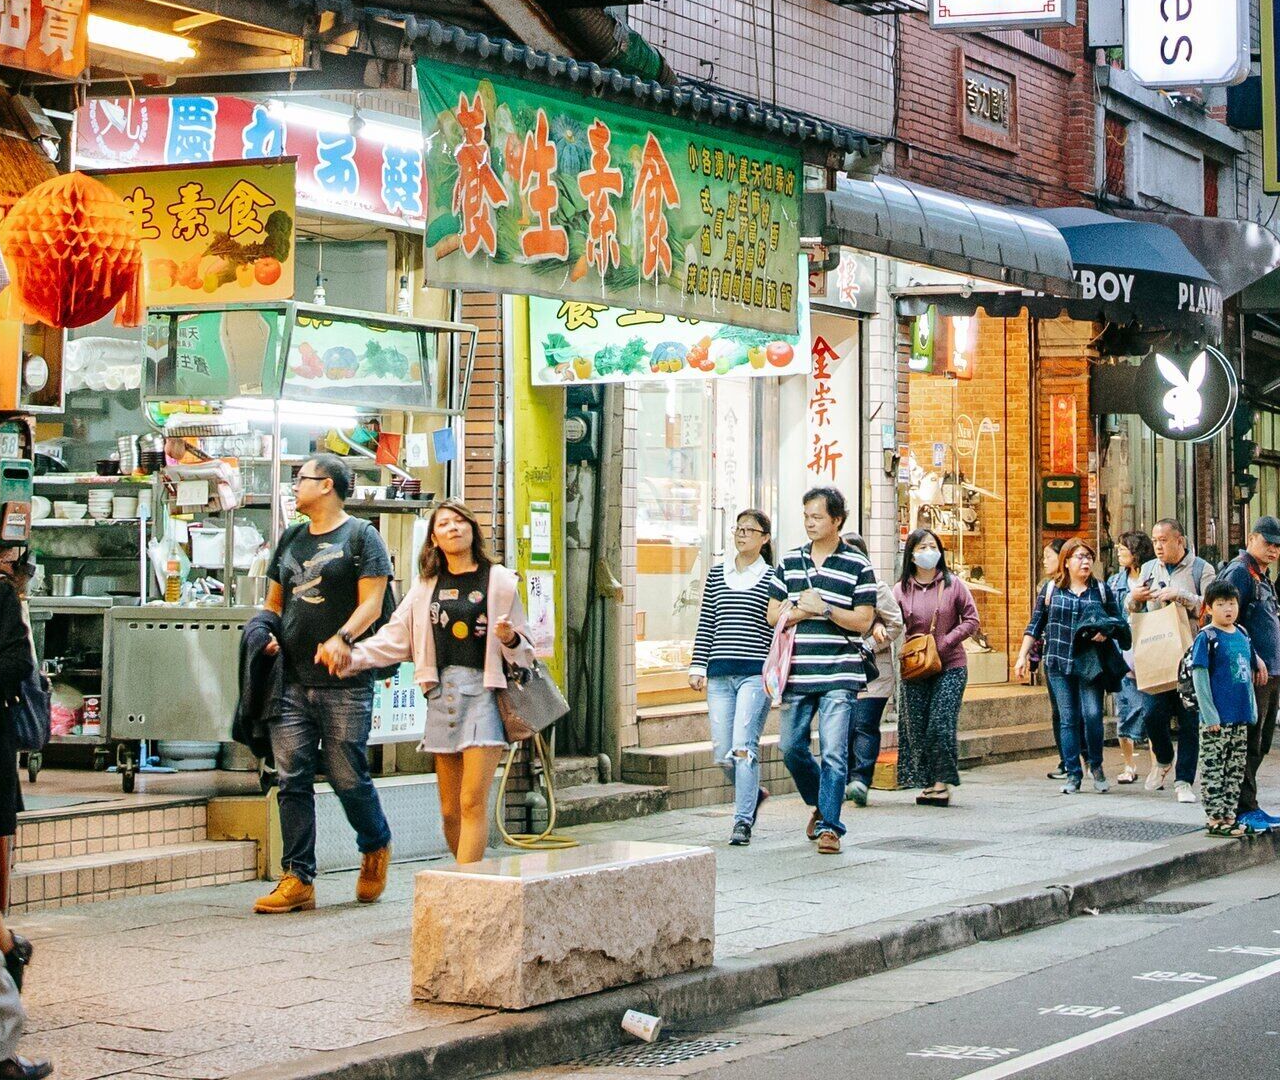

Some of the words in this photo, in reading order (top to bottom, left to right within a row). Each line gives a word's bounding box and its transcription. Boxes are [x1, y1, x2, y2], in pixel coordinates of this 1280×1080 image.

[451, 90, 682, 280] 養生素食
[807, 335, 843, 481] 金崇新
